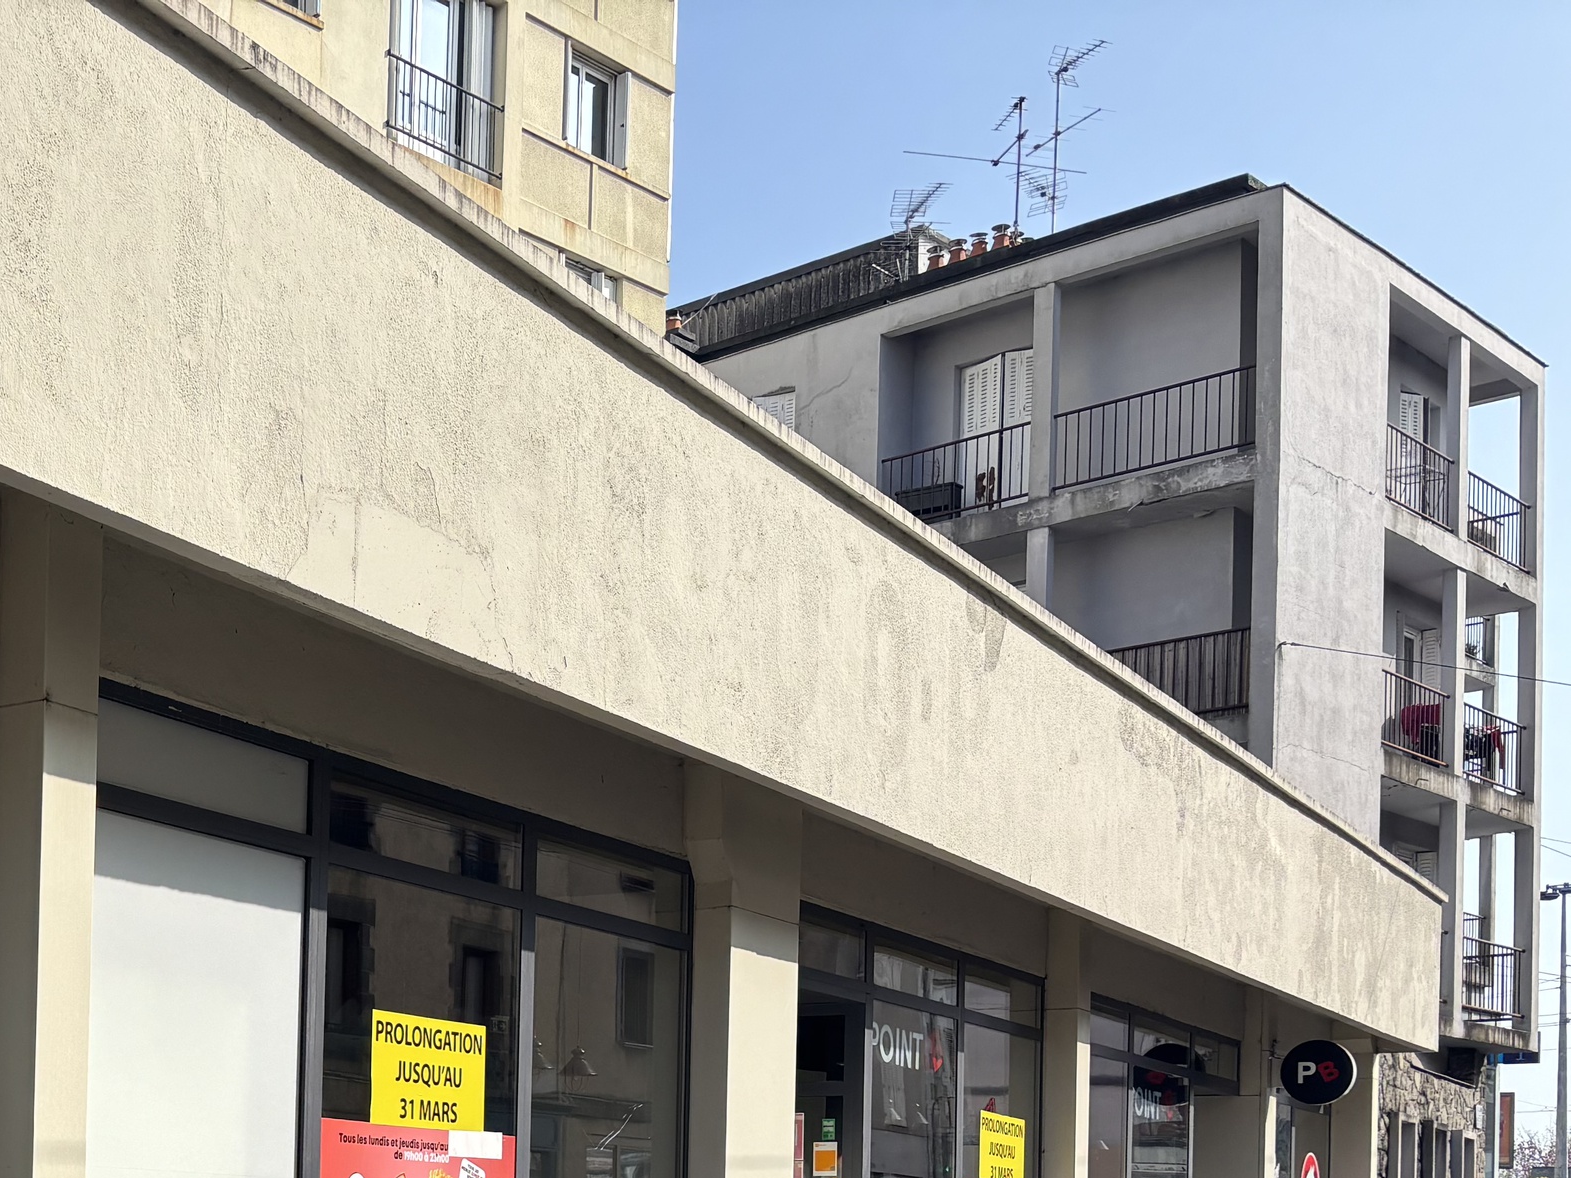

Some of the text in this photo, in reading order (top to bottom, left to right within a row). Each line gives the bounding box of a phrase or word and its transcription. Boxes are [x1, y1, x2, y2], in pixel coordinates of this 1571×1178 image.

[375, 1019, 483, 1055] PROLONGATION
[395, 1060, 463, 1089] JUSQU'AU
[399, 1098, 458, 1123] 31 MARS
[982, 1116, 1024, 1139] PROLONGATION
[339, 1132, 356, 1144] Tous
[356, 1133, 368, 1145] les
[368, 1135, 390, 1147] lundis
[390, 1139, 398, 1148] et
[398, 1137, 420, 1150] jeudis
[393, 1150, 403, 1160] de
[990, 1165, 997, 1178] 31
